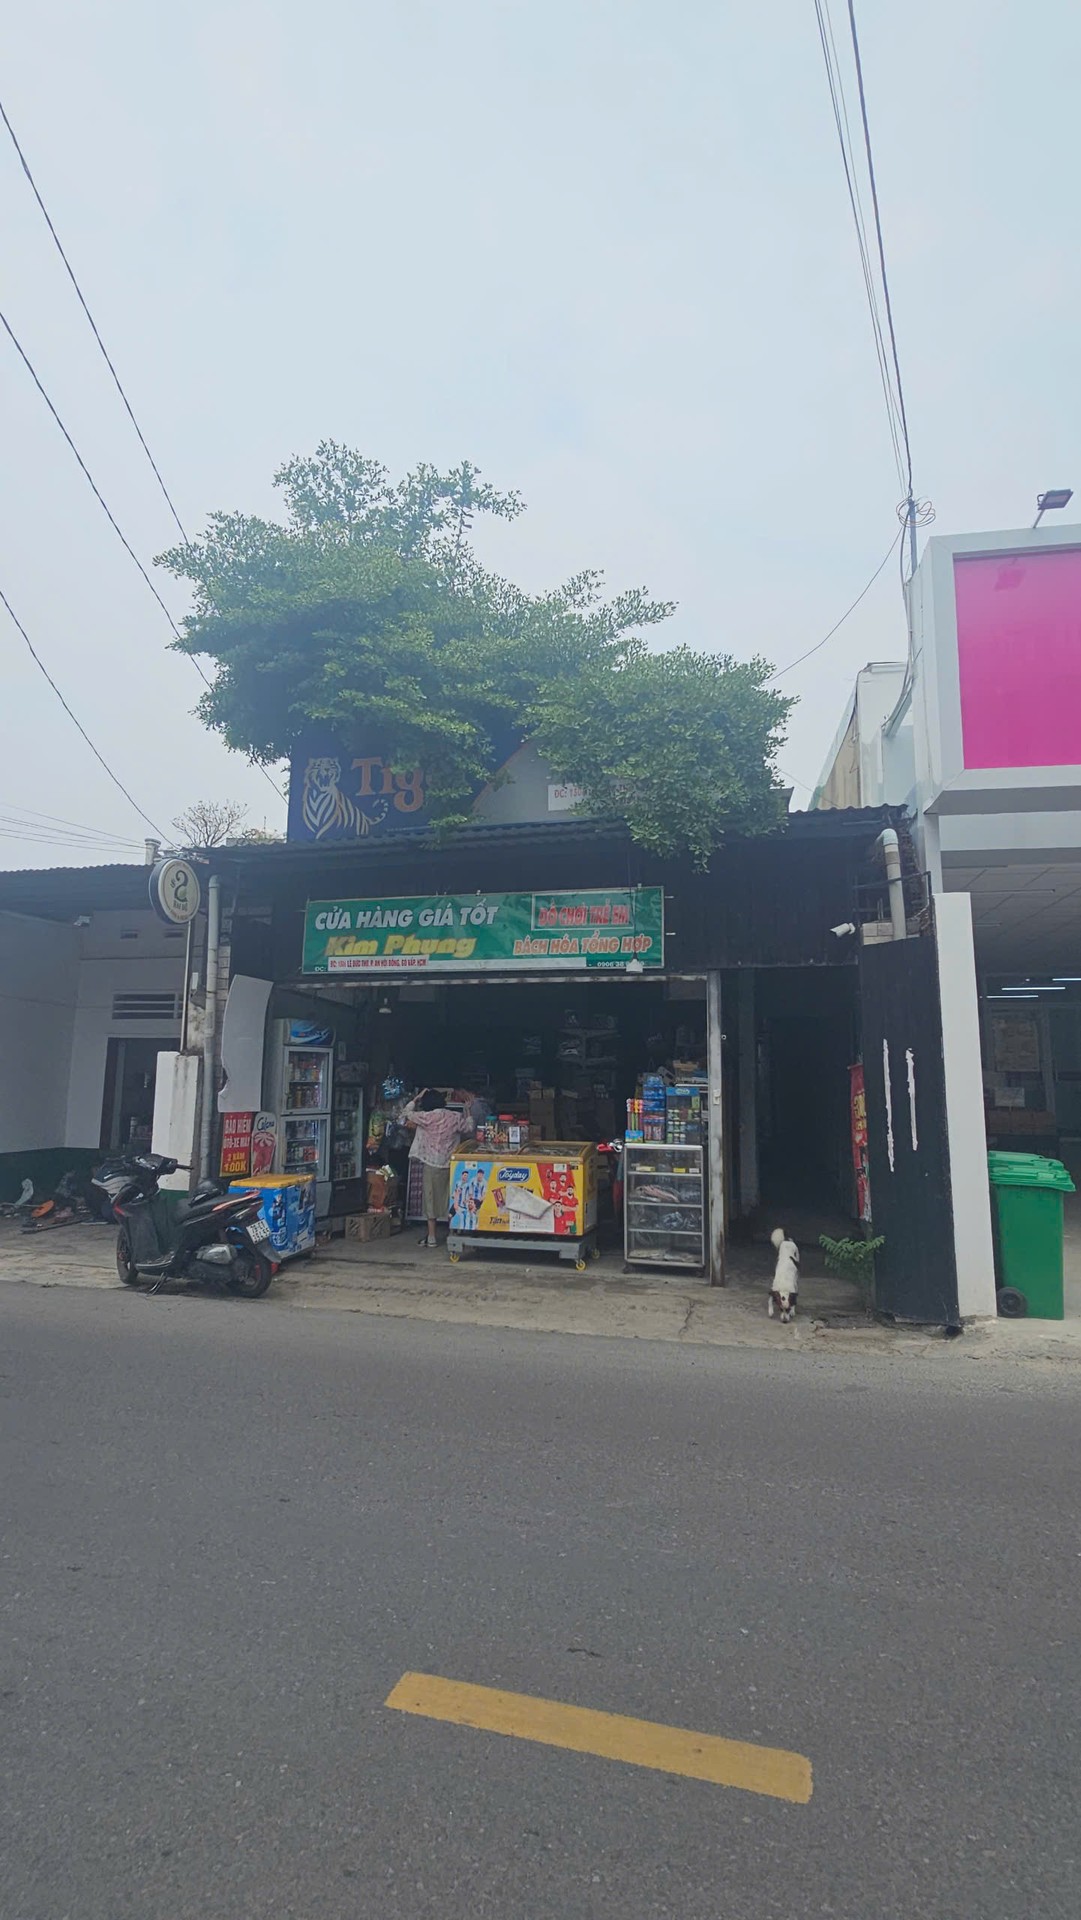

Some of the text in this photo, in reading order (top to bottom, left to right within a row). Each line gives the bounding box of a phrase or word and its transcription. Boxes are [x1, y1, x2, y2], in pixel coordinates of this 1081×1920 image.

[352, 757, 430, 813] Tig
[315, 898, 500, 930] CỬA HÀNG GIÁ TỐT
[538, 899, 629, 926] ĐỒ CHƠI TRẺ EM
[325, 934, 379, 957] Kim
[513, 930, 653, 956] BÁCH HÓA TỔNG HỢP
[223, 1114, 252, 1134] BẢO HIỂM
[223, 1160, 247, 1172] 100K
[232, 1152, 245, 1160] NĂM
